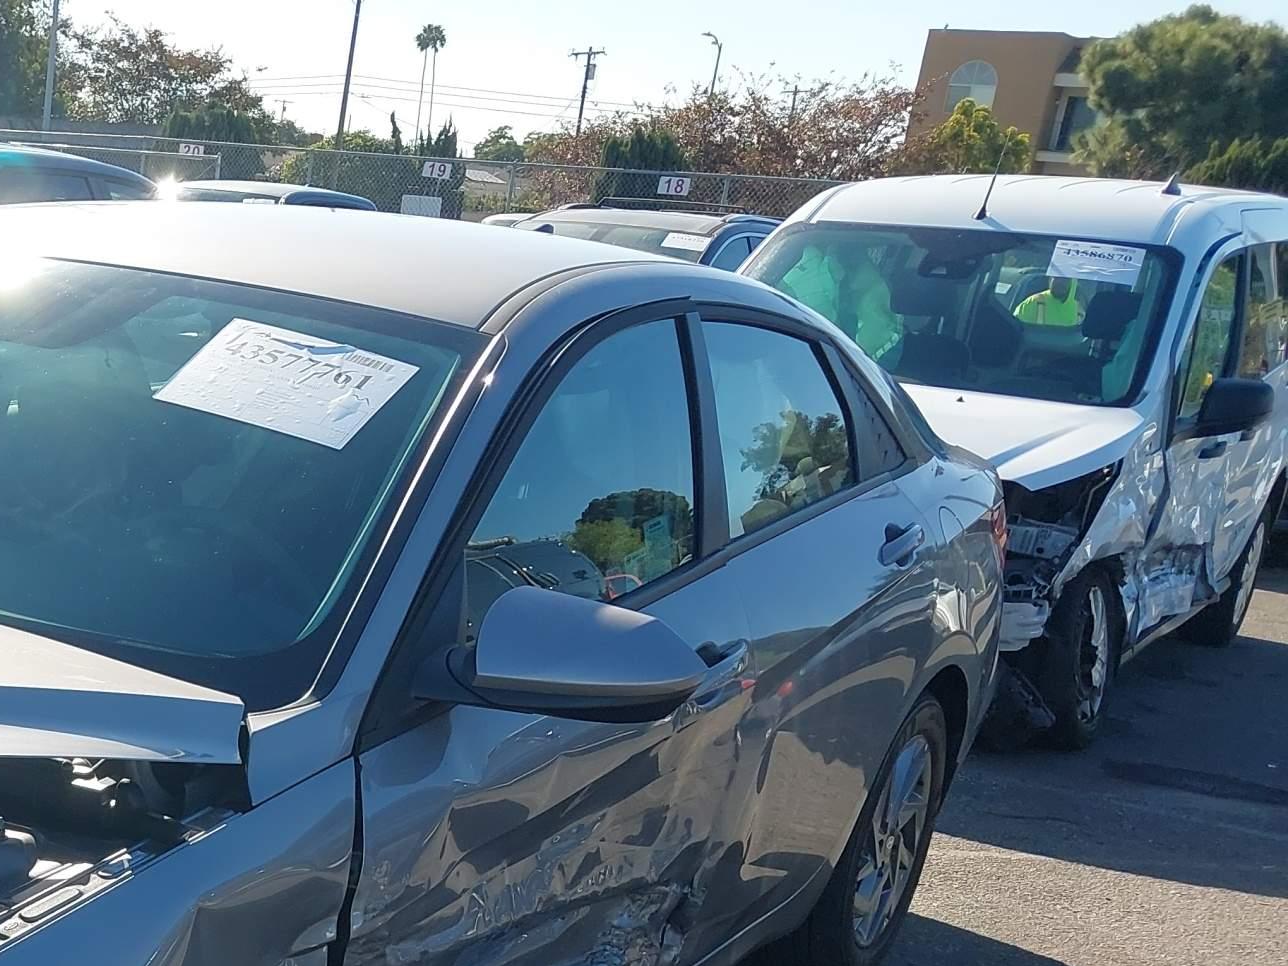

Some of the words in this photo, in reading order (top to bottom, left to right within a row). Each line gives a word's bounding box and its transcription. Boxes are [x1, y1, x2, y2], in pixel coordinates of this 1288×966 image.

[183, 144, 201, 156] 20
[428, 162, 447, 178] 19
[664, 177, 685, 194] 18
[224, 341, 374, 390] 43577761
